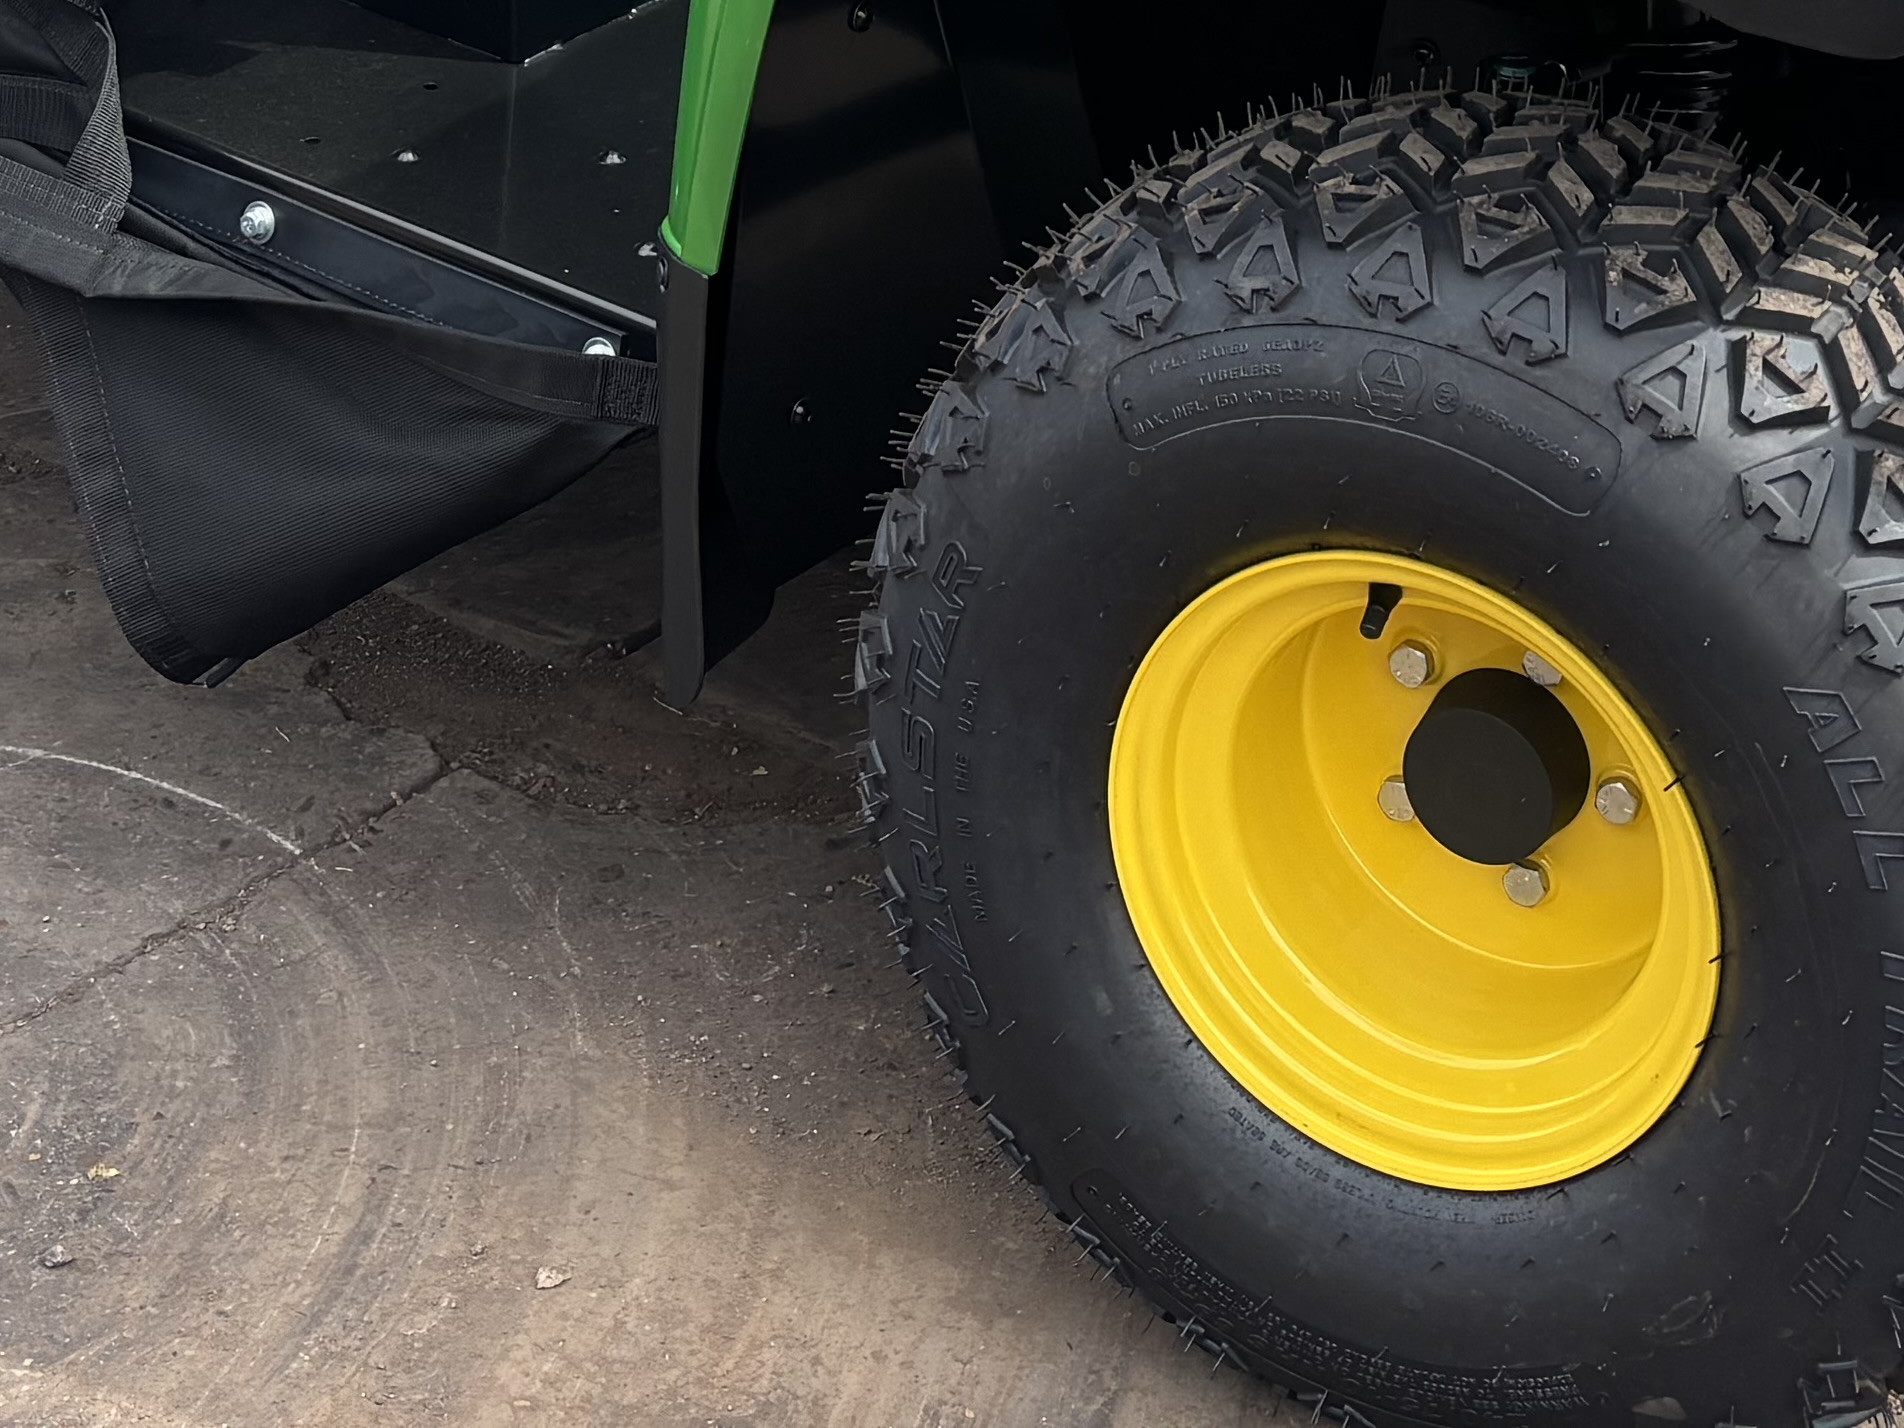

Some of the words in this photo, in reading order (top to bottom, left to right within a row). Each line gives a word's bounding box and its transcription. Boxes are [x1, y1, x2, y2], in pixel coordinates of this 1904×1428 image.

[898, 539, 989, 1027] CARLSTAR
[954, 750, 974, 795] THE
[954, 814, 973, 839] IN
